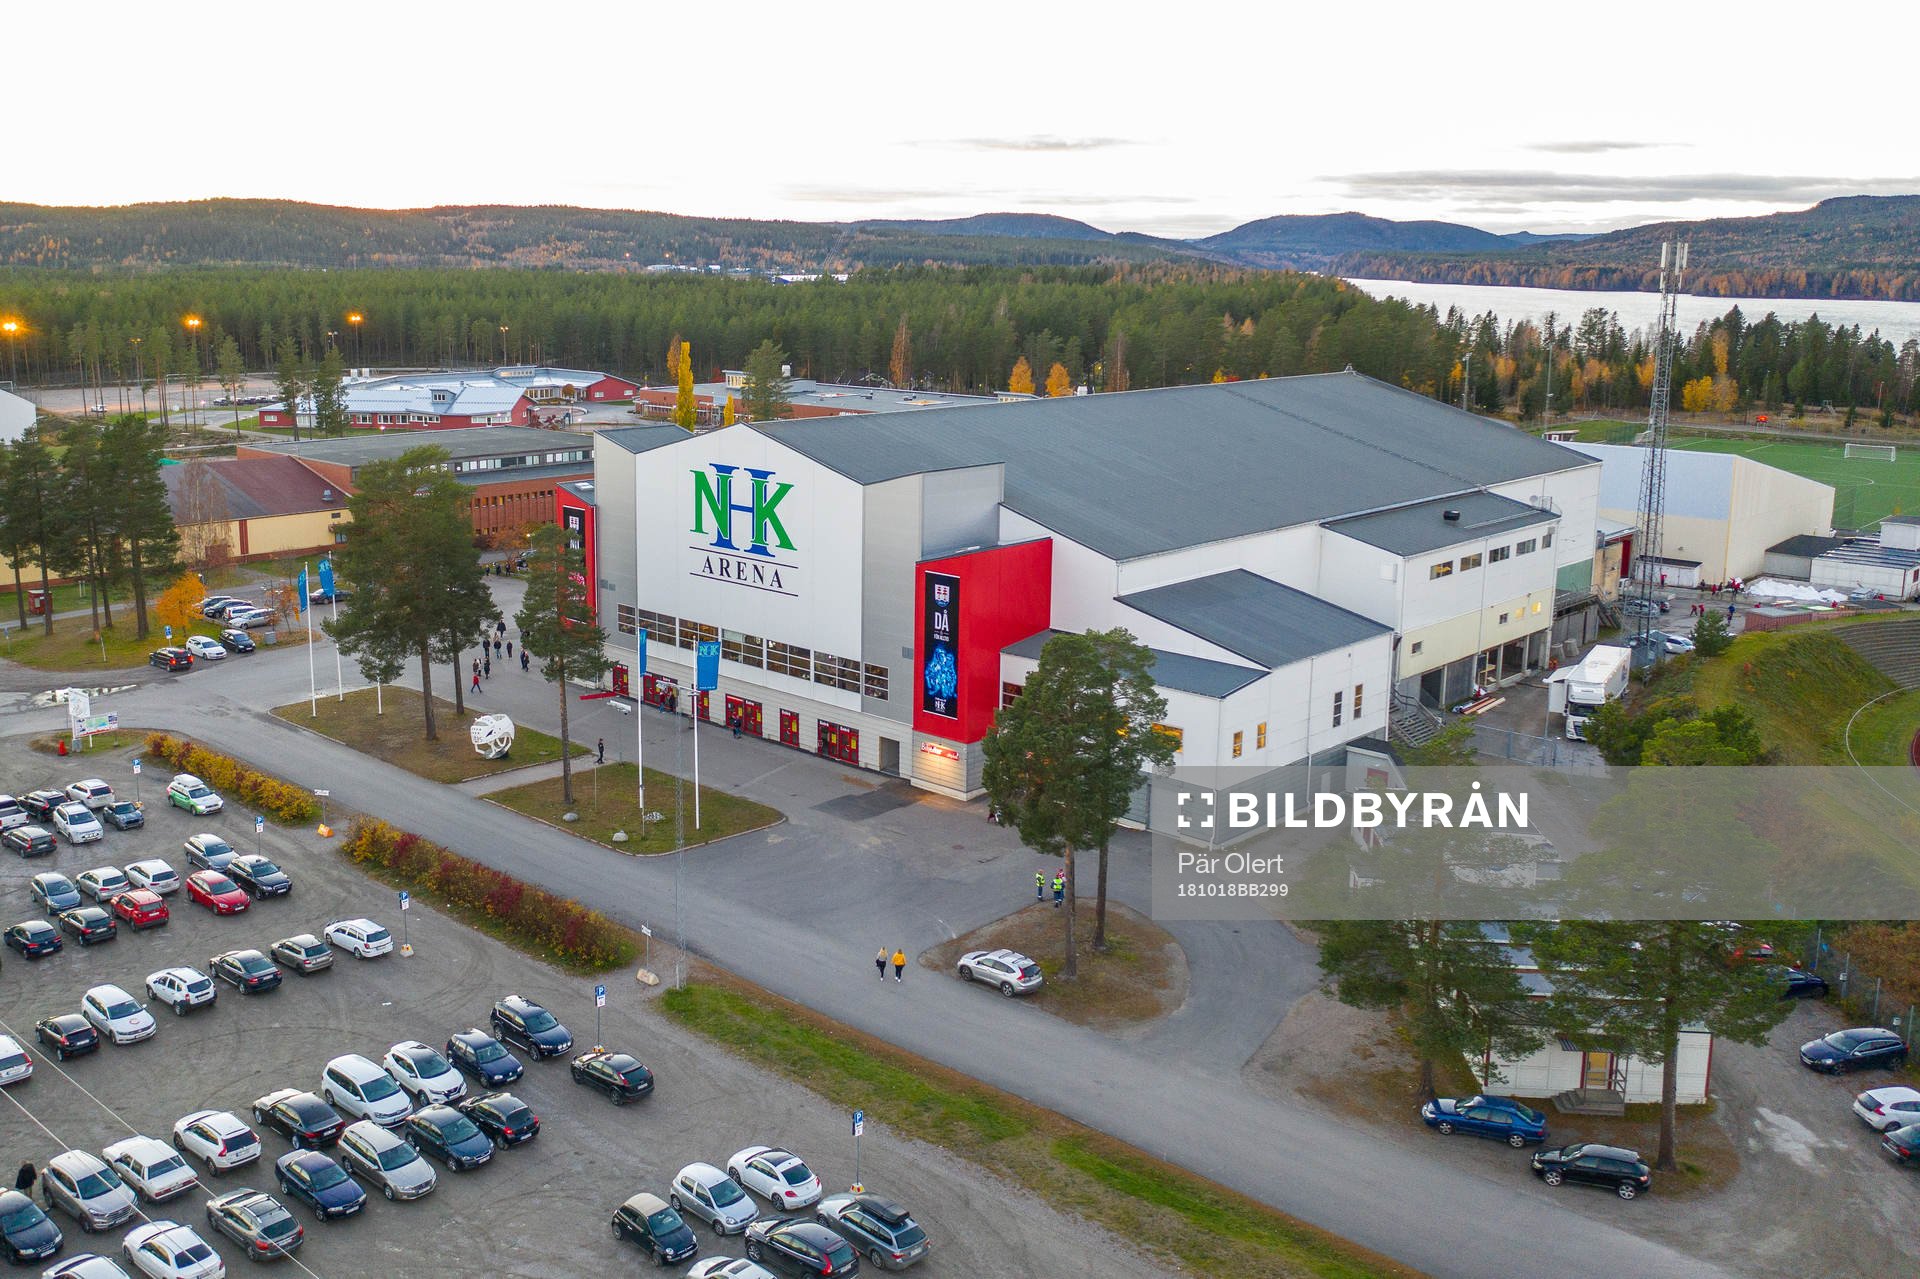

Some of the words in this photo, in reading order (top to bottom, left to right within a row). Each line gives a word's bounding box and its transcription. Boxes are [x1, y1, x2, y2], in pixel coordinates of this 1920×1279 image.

[689, 463, 798, 557] NHK
[702, 556, 783, 589] ARENA
[934, 609, 949, 631] DÅ
